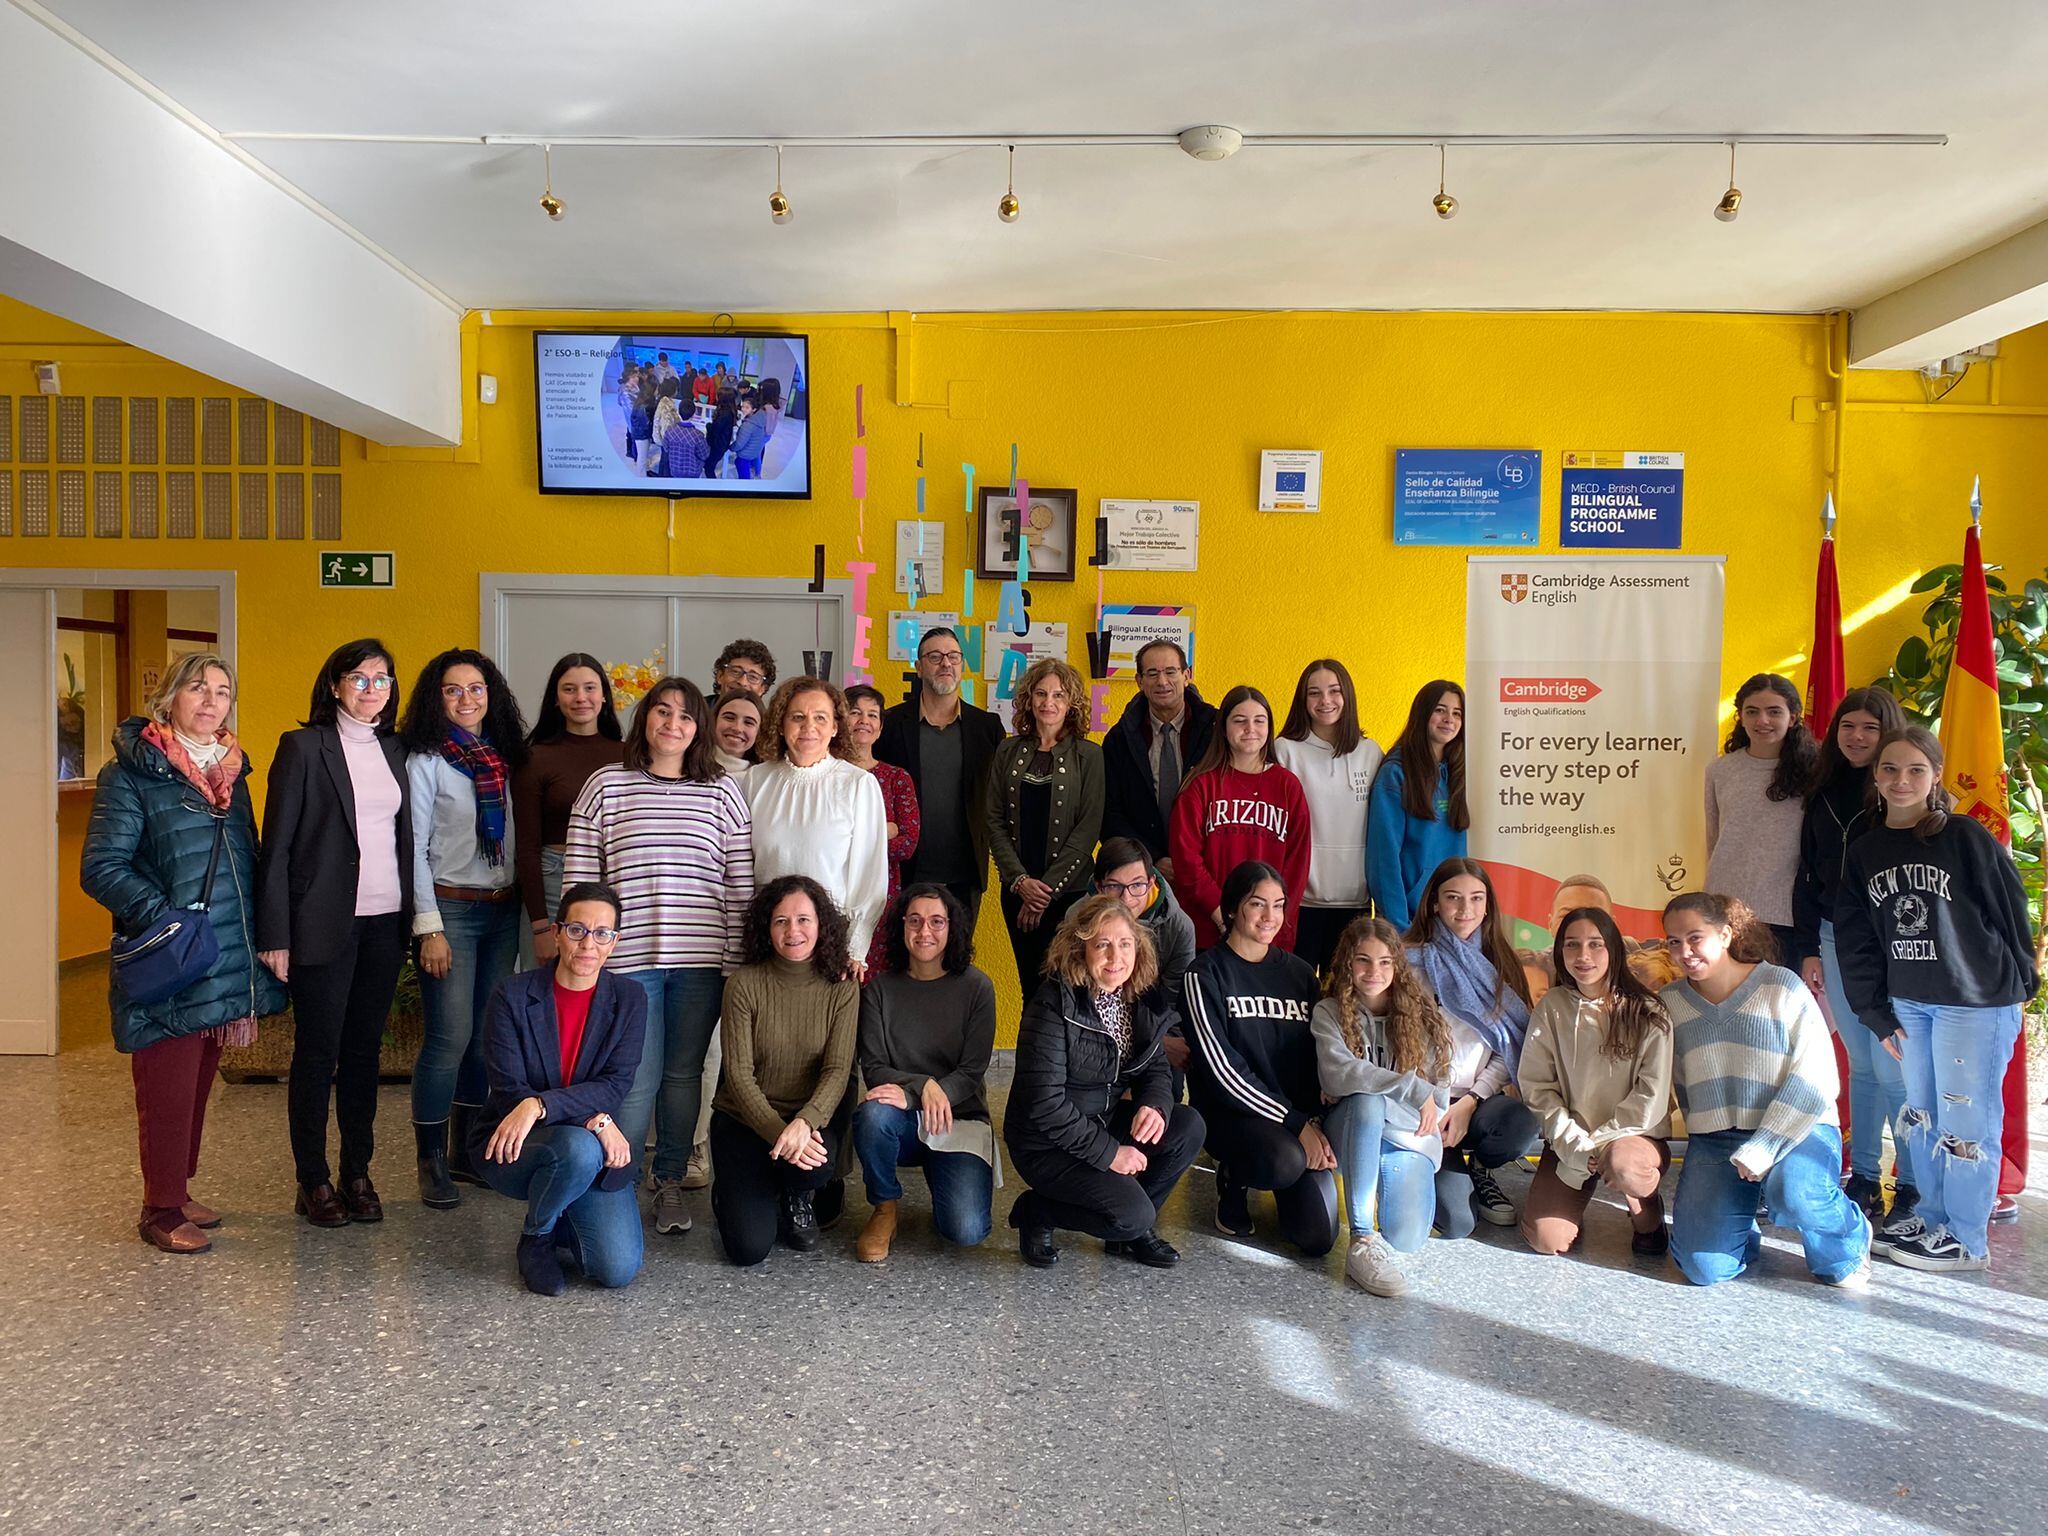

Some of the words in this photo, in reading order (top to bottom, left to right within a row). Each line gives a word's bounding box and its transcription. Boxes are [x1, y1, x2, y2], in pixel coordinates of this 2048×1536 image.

[555, 349, 581, 357] ESO-B
[1405, 477, 1430, 488] Sello
[1432, 477, 1444, 488] de
[1446, 477, 1483, 488] Calidad
[1571, 483, 1600, 493] MECD
[1608, 484, 1638, 493] British
[1639, 484, 1675, 494] Council
[1405, 486, 1457, 498] Enseñanza
[1460, 487, 1500, 500] Bilingüe
[1571, 495, 1642, 506] BILINGUAL
[1571, 508, 1657, 520] PROGRAMME
[1570, 521, 1625, 533] SCHOOL
[1136, 531, 1155, 540] Trabajo
[1156, 531, 1180, 539] Colectivo
[1532, 574, 1606, 590] Cambridge
[1609, 574, 1690, 588] Assessment
[1532, 590, 1577, 607] English
[1108, 625, 1141, 636] Bilingual
[1143, 626, 1182, 635] Education
[1155, 635, 1182, 643] School
[1504, 682, 1587, 700] Cambridge
[1504, 707, 1531, 717] English
[1532, 707, 1586, 717] Qualifications
[1501, 732, 1534, 750] For
[1539, 737, 1600, 756] every
[1605, 731, 1686, 755] learner,
[1499, 763, 1558, 784] every
[1564, 760, 1611, 784] step
[1617, 759, 1640, 778] of
[1499, 786, 1534, 805] the
[1540, 791, 1585, 812] way
[1498, 823, 1616, 837] cambridgeenglish.es
[1867, 866, 1900, 908] NEW
[1902, 864, 1953, 902] YORK
[1225, 995, 1310, 1023] ADIDAS
